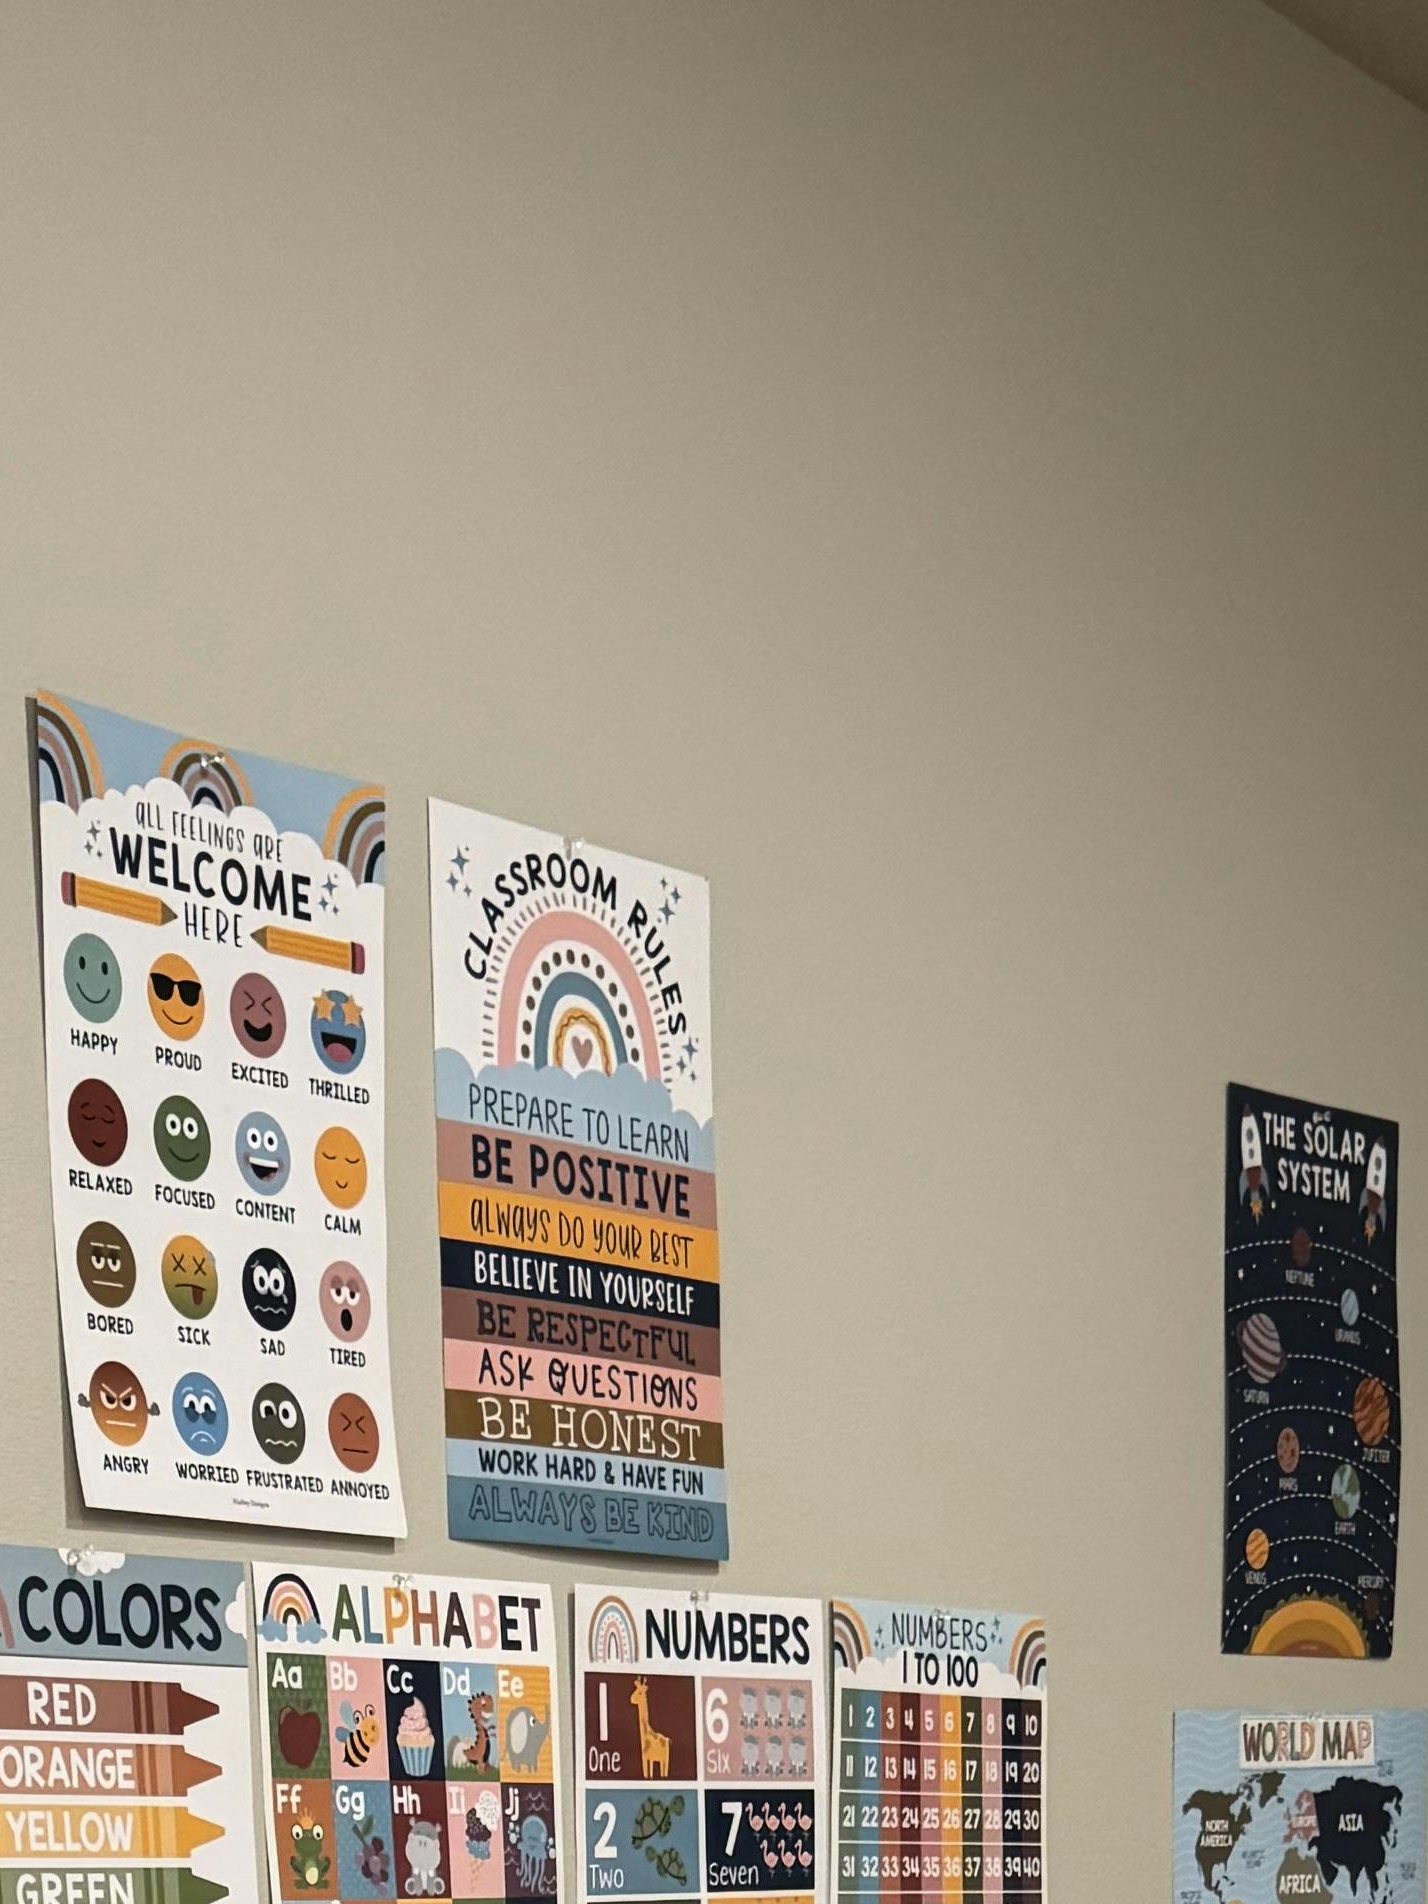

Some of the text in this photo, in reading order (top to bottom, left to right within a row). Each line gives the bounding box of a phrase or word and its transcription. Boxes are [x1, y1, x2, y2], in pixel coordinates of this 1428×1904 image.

[109, 827, 312, 921] WELCOME
[184, 902, 243, 948] HERE
[465, 853, 686, 1036] CLASSROOM RULES
[469, 1083, 689, 1163] PREPARE TO LEARN
[1263, 1112, 1365, 1165] THE SOLAR
[471, 1134, 690, 1219] BE POSITIVE
[1277, 1157, 1350, 1203] SYSTEM
[69, 1169, 362, 1236] RELAXED FOCUSED CONTENT CALM
[476, 1299, 696, 1367] BE RESPECTFUL
[478, 1398, 701, 1462] BE HONEST
[103, 1455, 390, 1501] ANGRY WORRIED FRUSTRATED ANNOYED
[479, 1448, 704, 1495] WORK HARD & HAVE FUN
[19, 1575, 222, 1652] COLORS
[332, 1584, 541, 1652] ALPHABET
[646, 1608, 810, 1665] NUMBERS
[892, 1612, 987, 1652] NUMBERS
[915, 1652, 939, 1684] TO
[947, 1654, 978, 1687] 100
[28, 1682, 96, 1726] RED
[588, 1746, 621, 1773] One
[1243, 1721, 1372, 1762] WORLD MAP
[5, 1811, 134, 1853] YELLOW
[1338, 1814, 1363, 1831] ASIA
[709, 1862, 759, 1886] Seven
[1279, 1874, 1321, 1894] AFRICA
